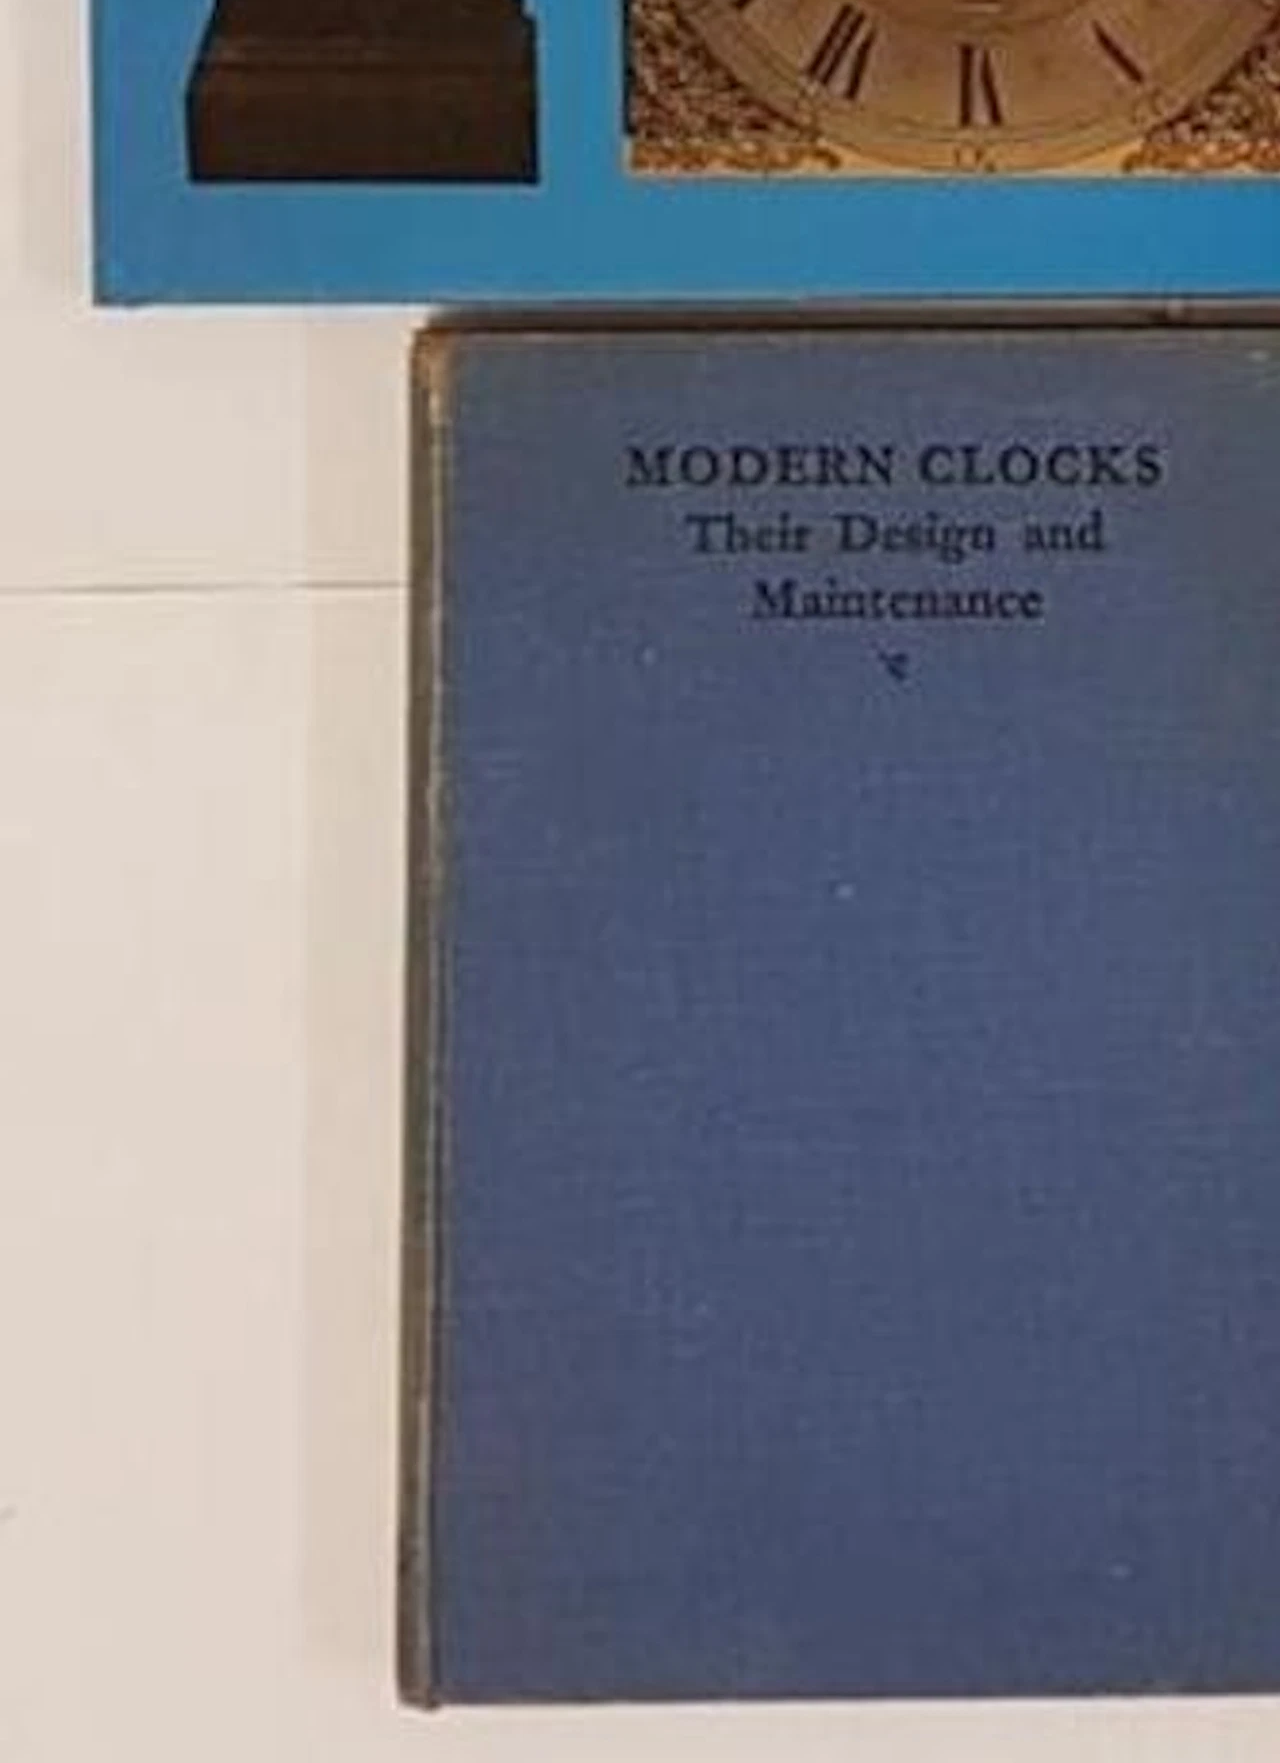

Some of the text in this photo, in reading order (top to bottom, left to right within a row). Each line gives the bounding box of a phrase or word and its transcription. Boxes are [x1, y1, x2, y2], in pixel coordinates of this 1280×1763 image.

[625, 446, 1164, 488] MODERN CLOCKS
[685, 512, 1107, 564] Their Design and
[751, 579, 1045, 622] Maintenance
